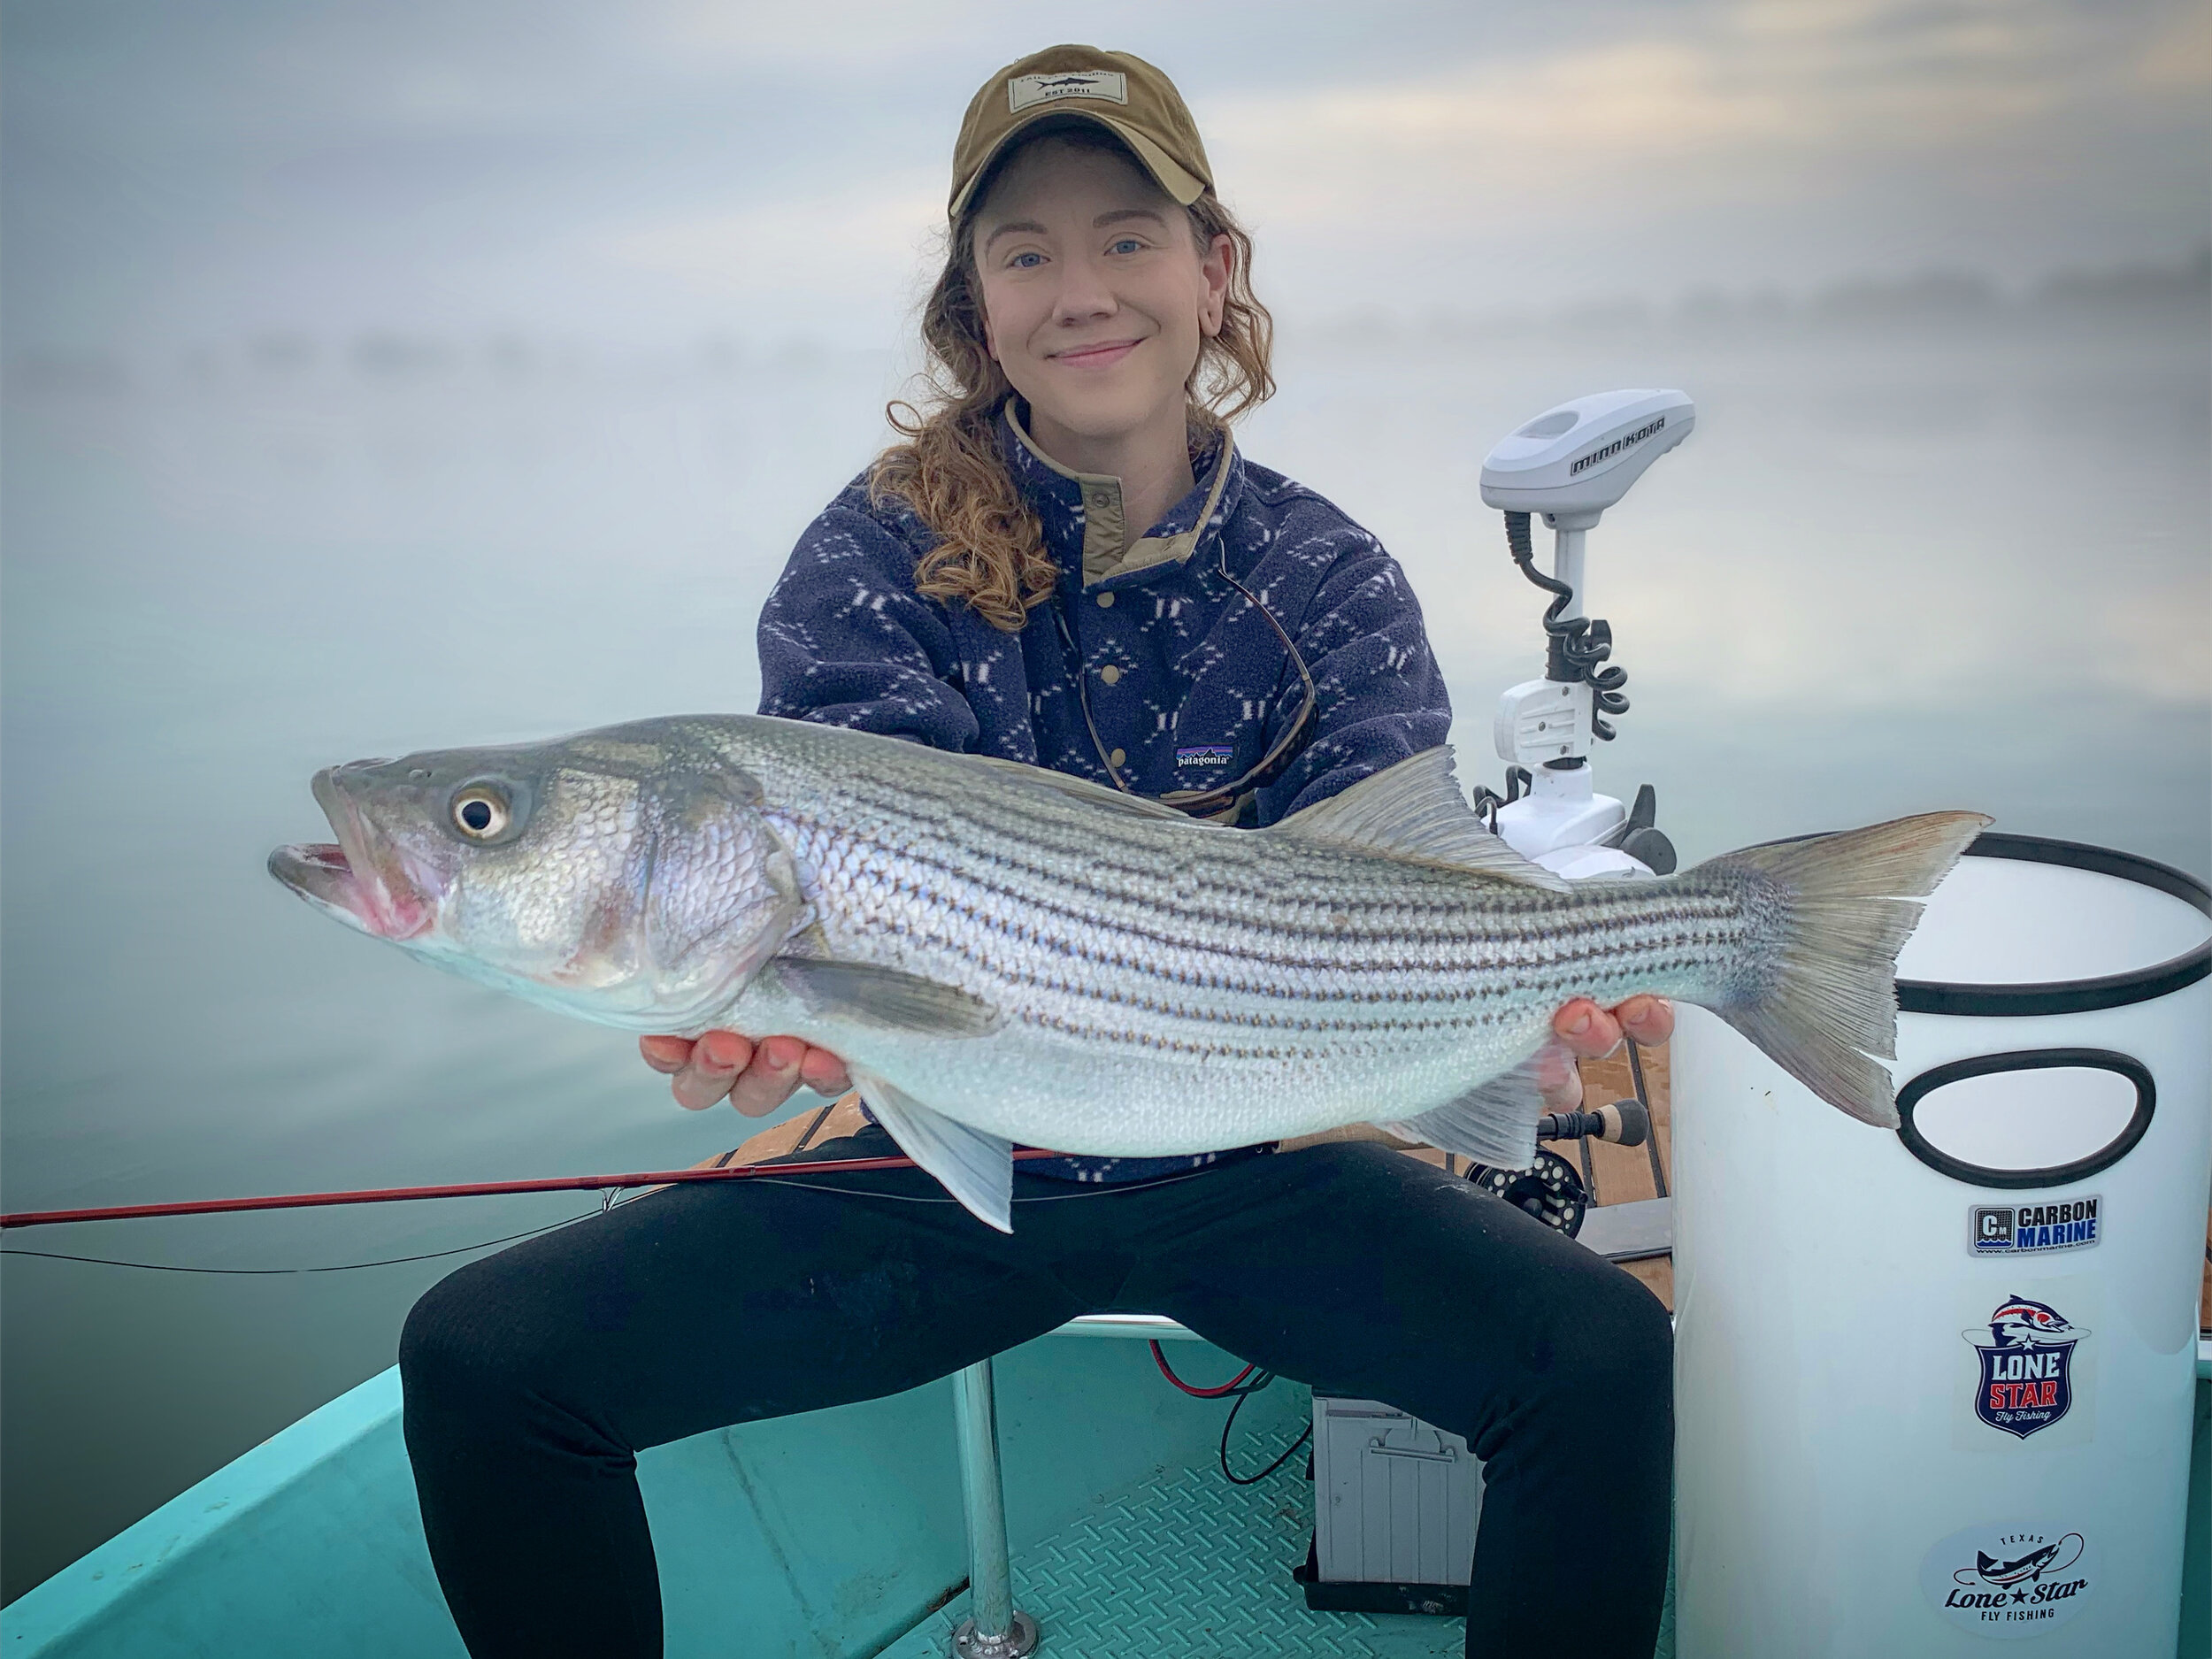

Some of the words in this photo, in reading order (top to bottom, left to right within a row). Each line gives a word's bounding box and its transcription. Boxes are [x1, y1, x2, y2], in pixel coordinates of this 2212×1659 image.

[1624, 417, 1666, 447] KOTA
[1178, 756, 1227, 767] patagonia
[2017, 1198, 2098, 1227] CARBON
[1976, 1239, 2095, 1254] www.carbonmarine.com
[2016, 1218, 2097, 1248] MARINE
[1991, 1352, 2061, 1381] LONE
[1989, 1380, 2058, 1409] STAR
[1995, 1411, 2014, 1423] Fly
[2015, 1410, 2052, 1422] Fishing
[2000, 1533, 2045, 1546] TEXAS
[1944, 1588, 2008, 1609] Lone
[2030, 1578, 2089, 1605] Star
[1981, 1611, 2001, 1621] FLY
[2006, 1608, 2055, 1621] FISHING
